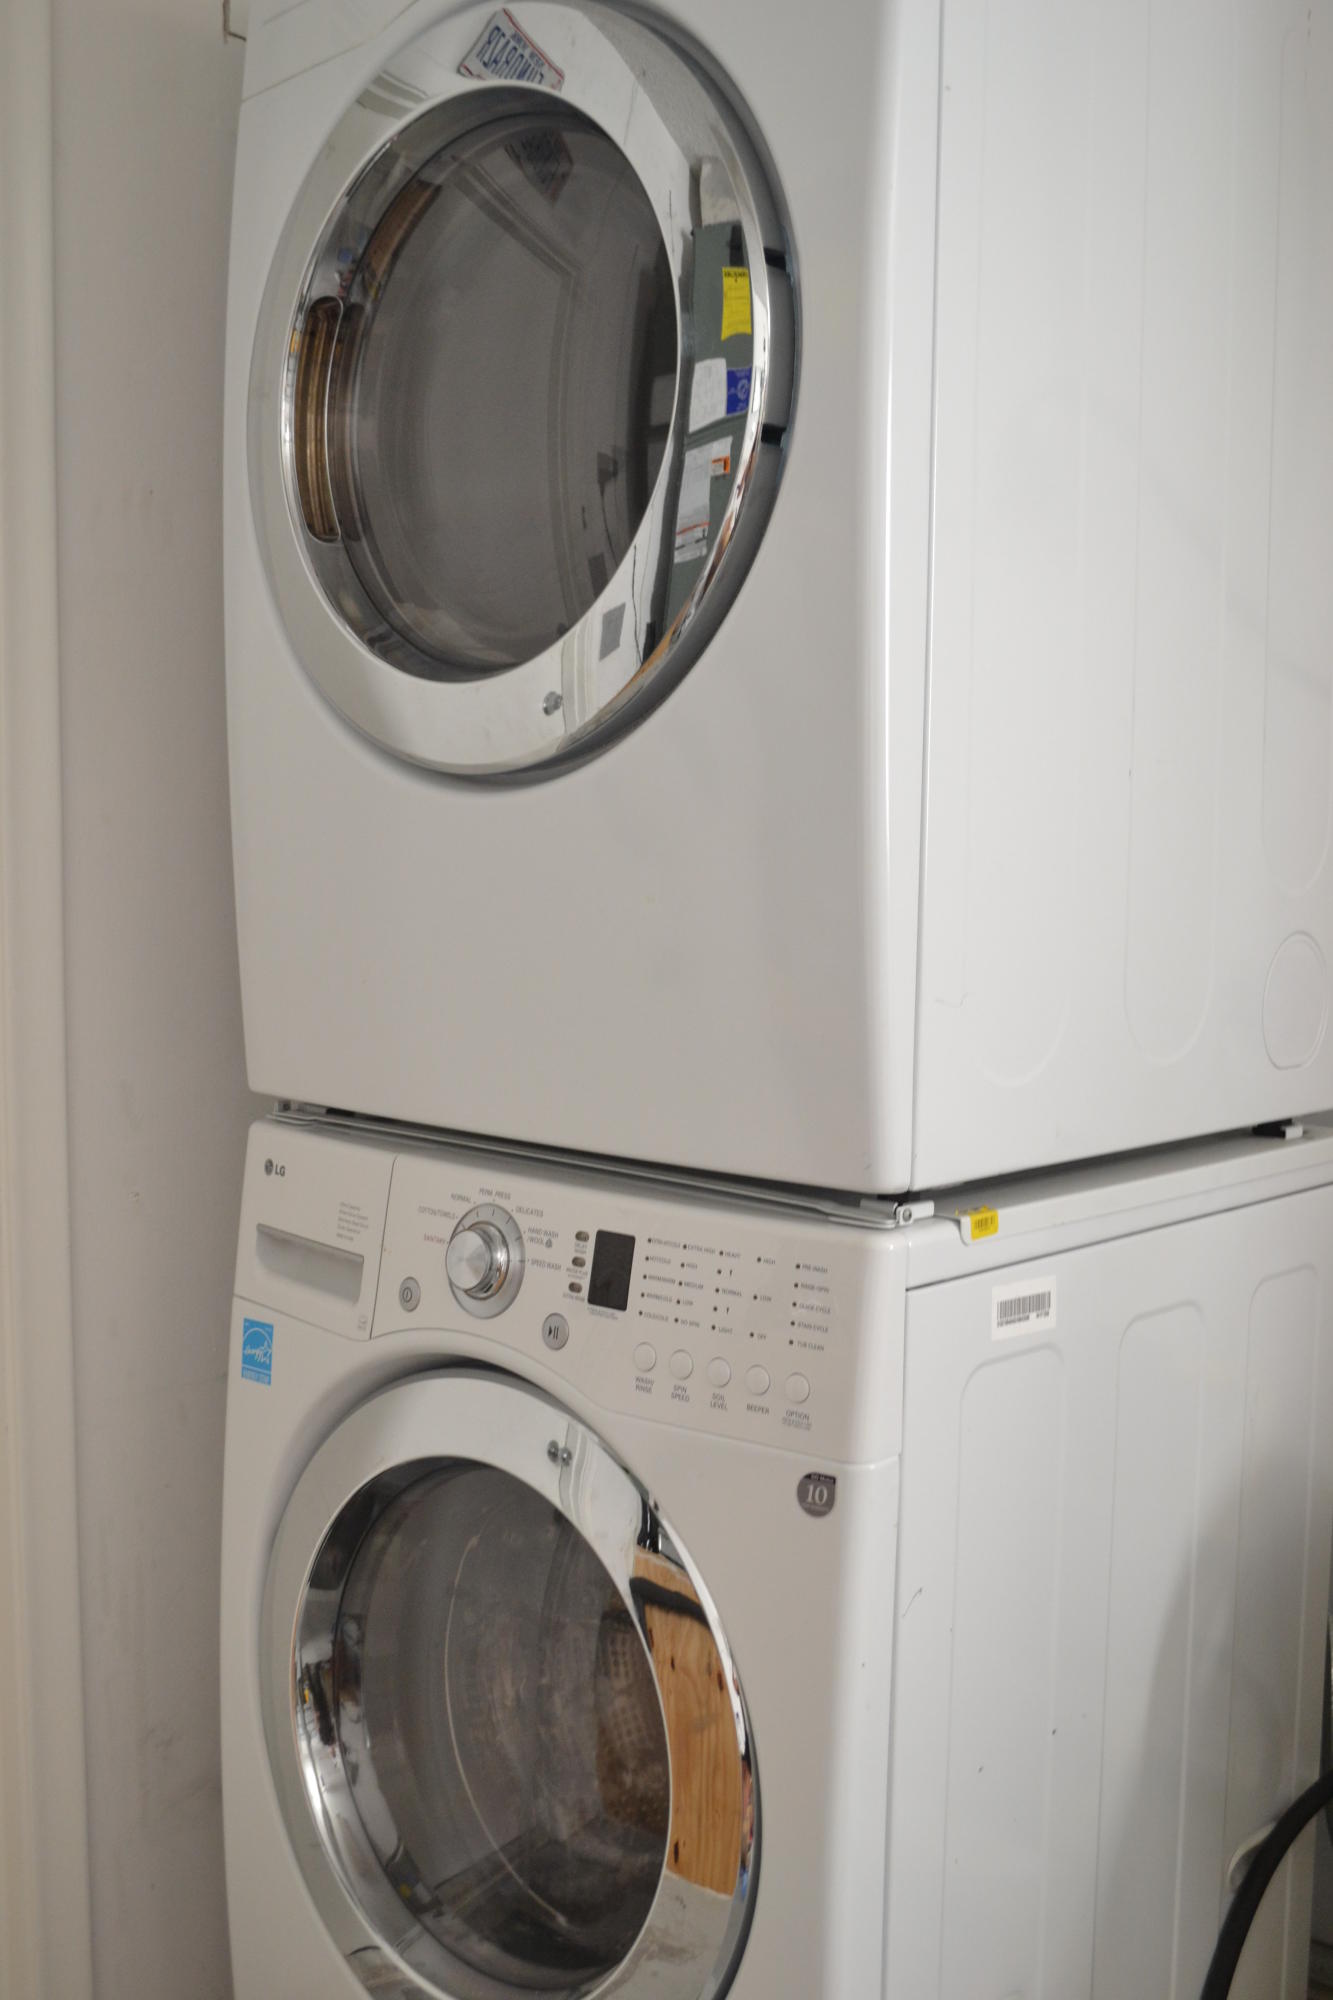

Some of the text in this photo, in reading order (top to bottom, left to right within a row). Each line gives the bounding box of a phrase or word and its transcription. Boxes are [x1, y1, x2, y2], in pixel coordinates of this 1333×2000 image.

[275, 1163, 286, 1177] LG
[515, 1206, 544, 1218] DELICATES
[635, 1384, 653, 1395] RINSE
[673, 1384, 688, 1394] SPIN
[671, 1392, 691, 1403] SPEED
[712, 1392, 726, 1402] SOIL
[710, 1401, 728, 1412] LEVEL
[746, 1403, 770, 1415] BEEPER
[785, 1409, 811, 1422] OPTION
[806, 1484, 828, 1505] 10
